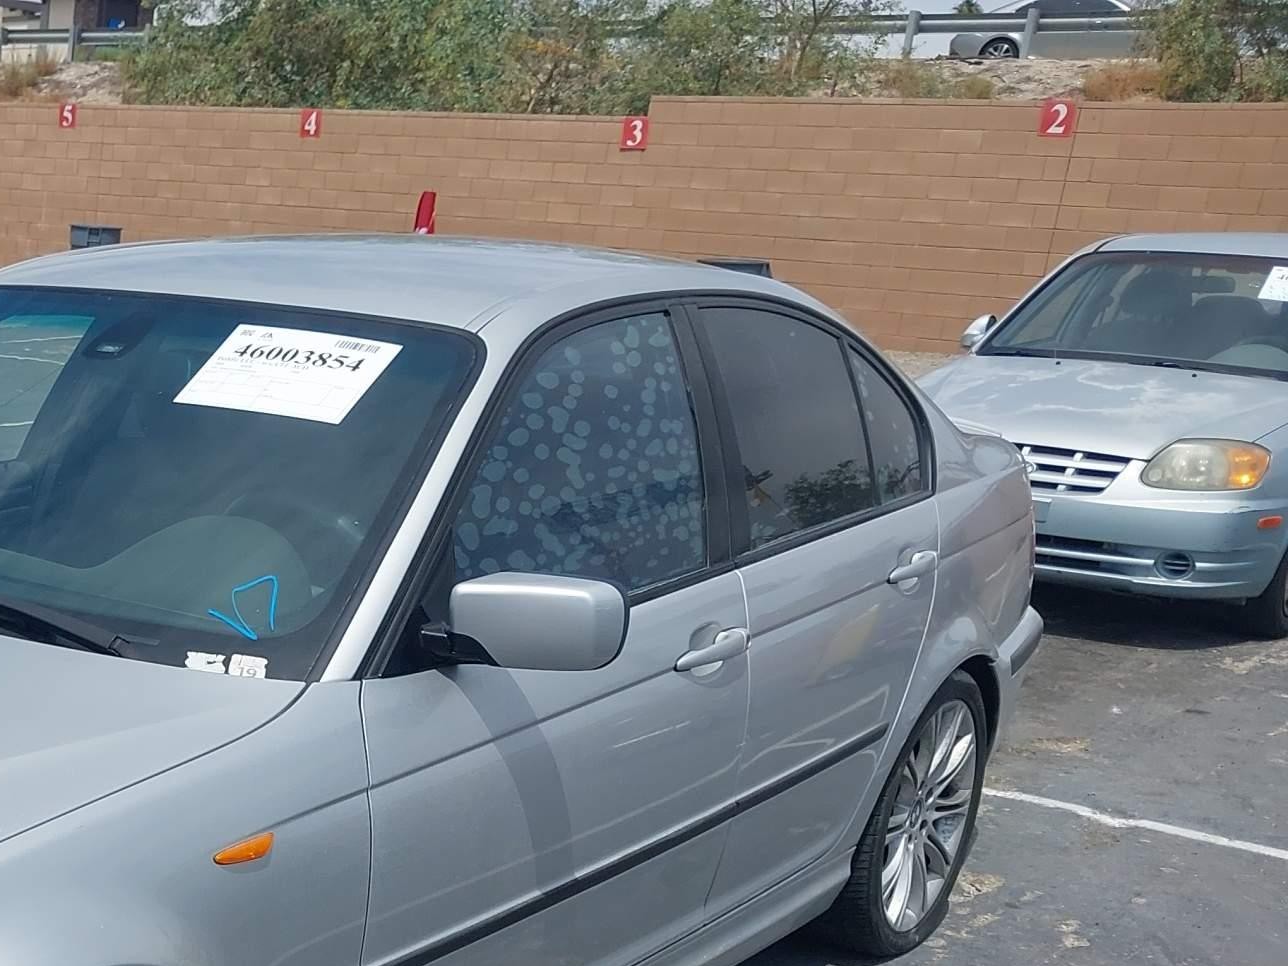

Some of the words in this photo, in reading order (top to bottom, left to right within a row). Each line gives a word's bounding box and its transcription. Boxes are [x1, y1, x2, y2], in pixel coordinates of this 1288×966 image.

[62, 105, 73, 127] 5
[304, 111, 317, 136] 4
[1046, 103, 1068, 134] 2
[626, 120, 643, 146] 3
[234, 343, 366, 372] 46003854
